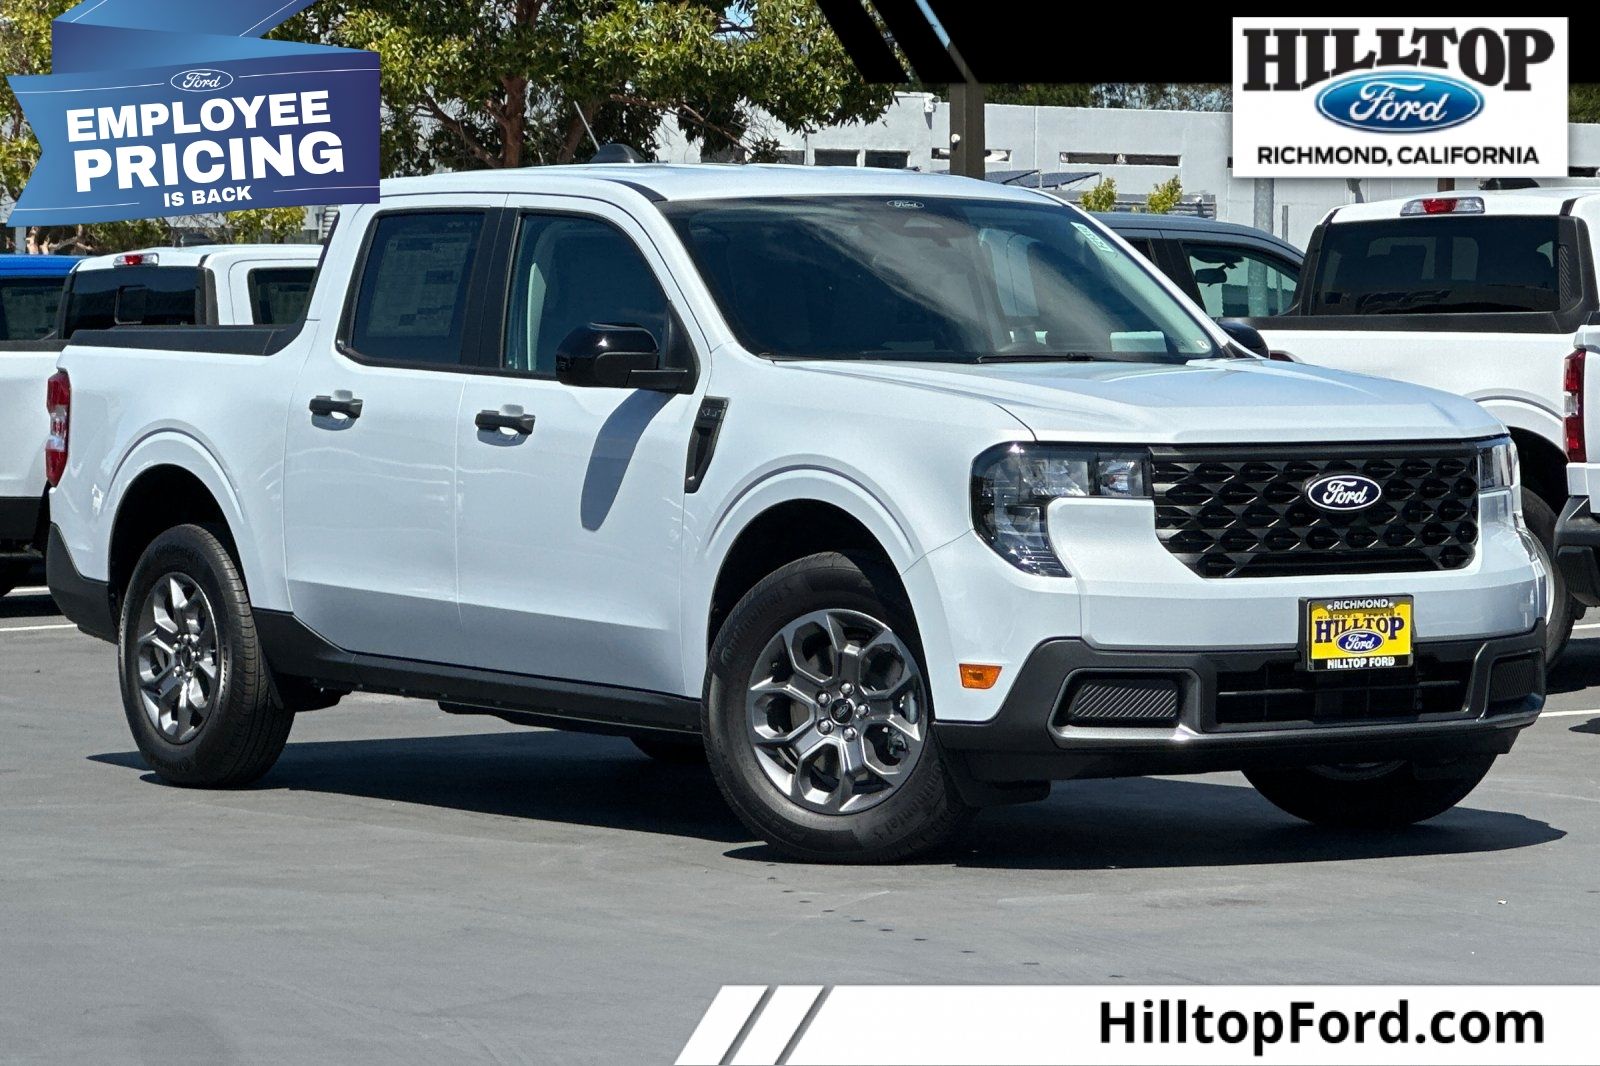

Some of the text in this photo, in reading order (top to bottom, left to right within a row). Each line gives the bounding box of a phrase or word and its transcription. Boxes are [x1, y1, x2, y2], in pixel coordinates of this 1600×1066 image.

[1322, 480, 1368, 505] Ford
[1333, 598, 1389, 610] RICHMOND
[1314, 616, 1405, 644] HILLTOP
[1345, 633, 1375, 650] Ford
[1327, 656, 1396, 670] HILLTOP FORD
